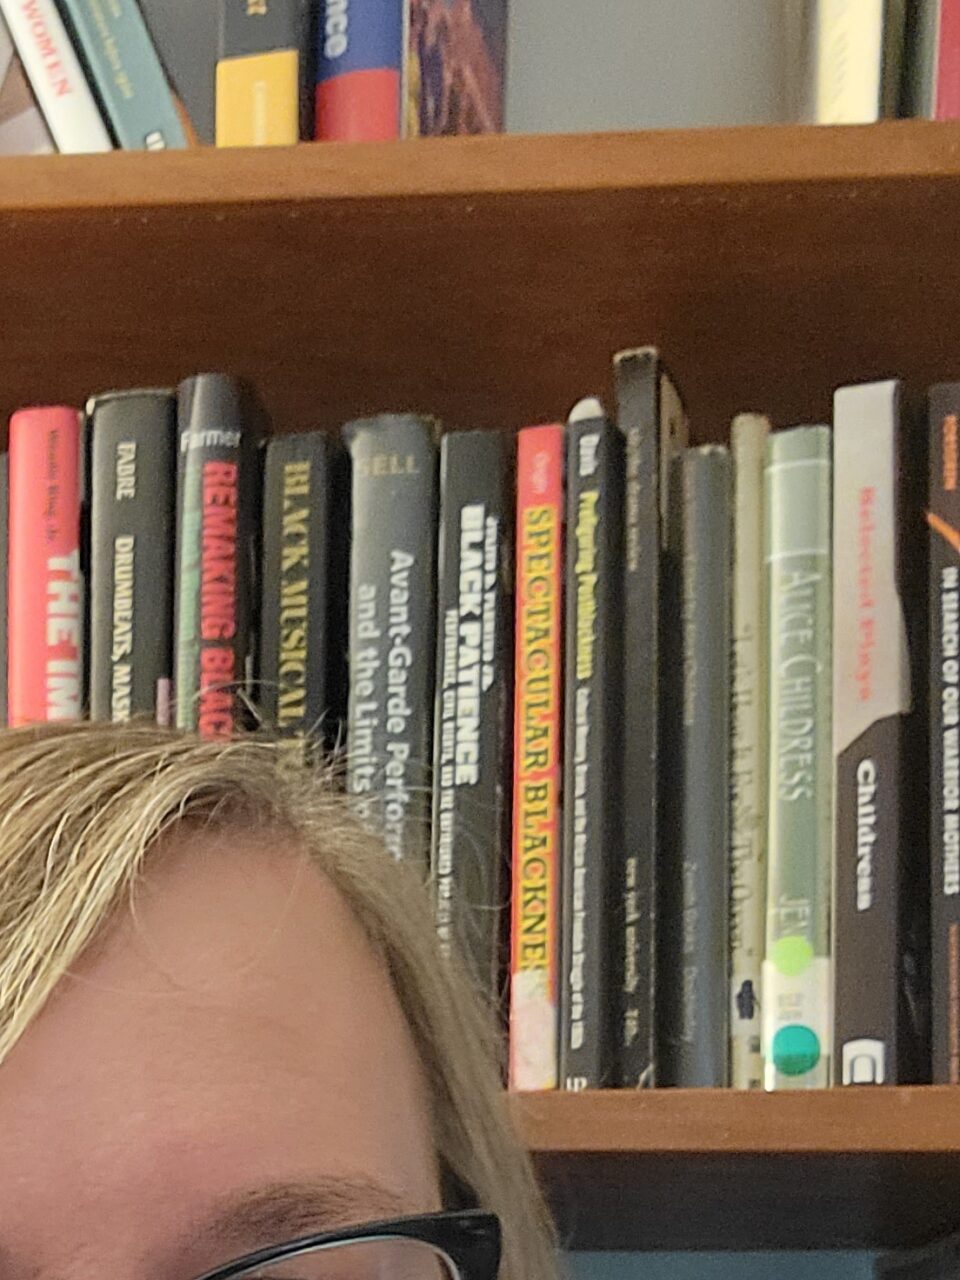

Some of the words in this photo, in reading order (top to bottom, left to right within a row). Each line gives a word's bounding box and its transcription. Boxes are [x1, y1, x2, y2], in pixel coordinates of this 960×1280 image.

[115, 442, 137, 501] FABRE
[280, 460, 312, 574] BLACK
[45, 547, 81, 647] THE
[200, 461, 237, 640] REMAKING
[459, 504, 486, 617] BLACK
[277, 577, 310, 728] MUSICAL
[356, 583, 382, 640] and
[385, 549, 416, 734] Avant-Garde
[522, 507, 553, 771] SPECTACULAR
[777, 571, 823, 646] ALICE
[850, 617, 877, 704] Plays
[353, 646, 382, 698] the
[455, 622, 482, 787] PATIENCE
[942, 659, 959, 684] OF
[350, 701, 379, 795] Limits
[776, 654, 823, 802] CHILDRESS
